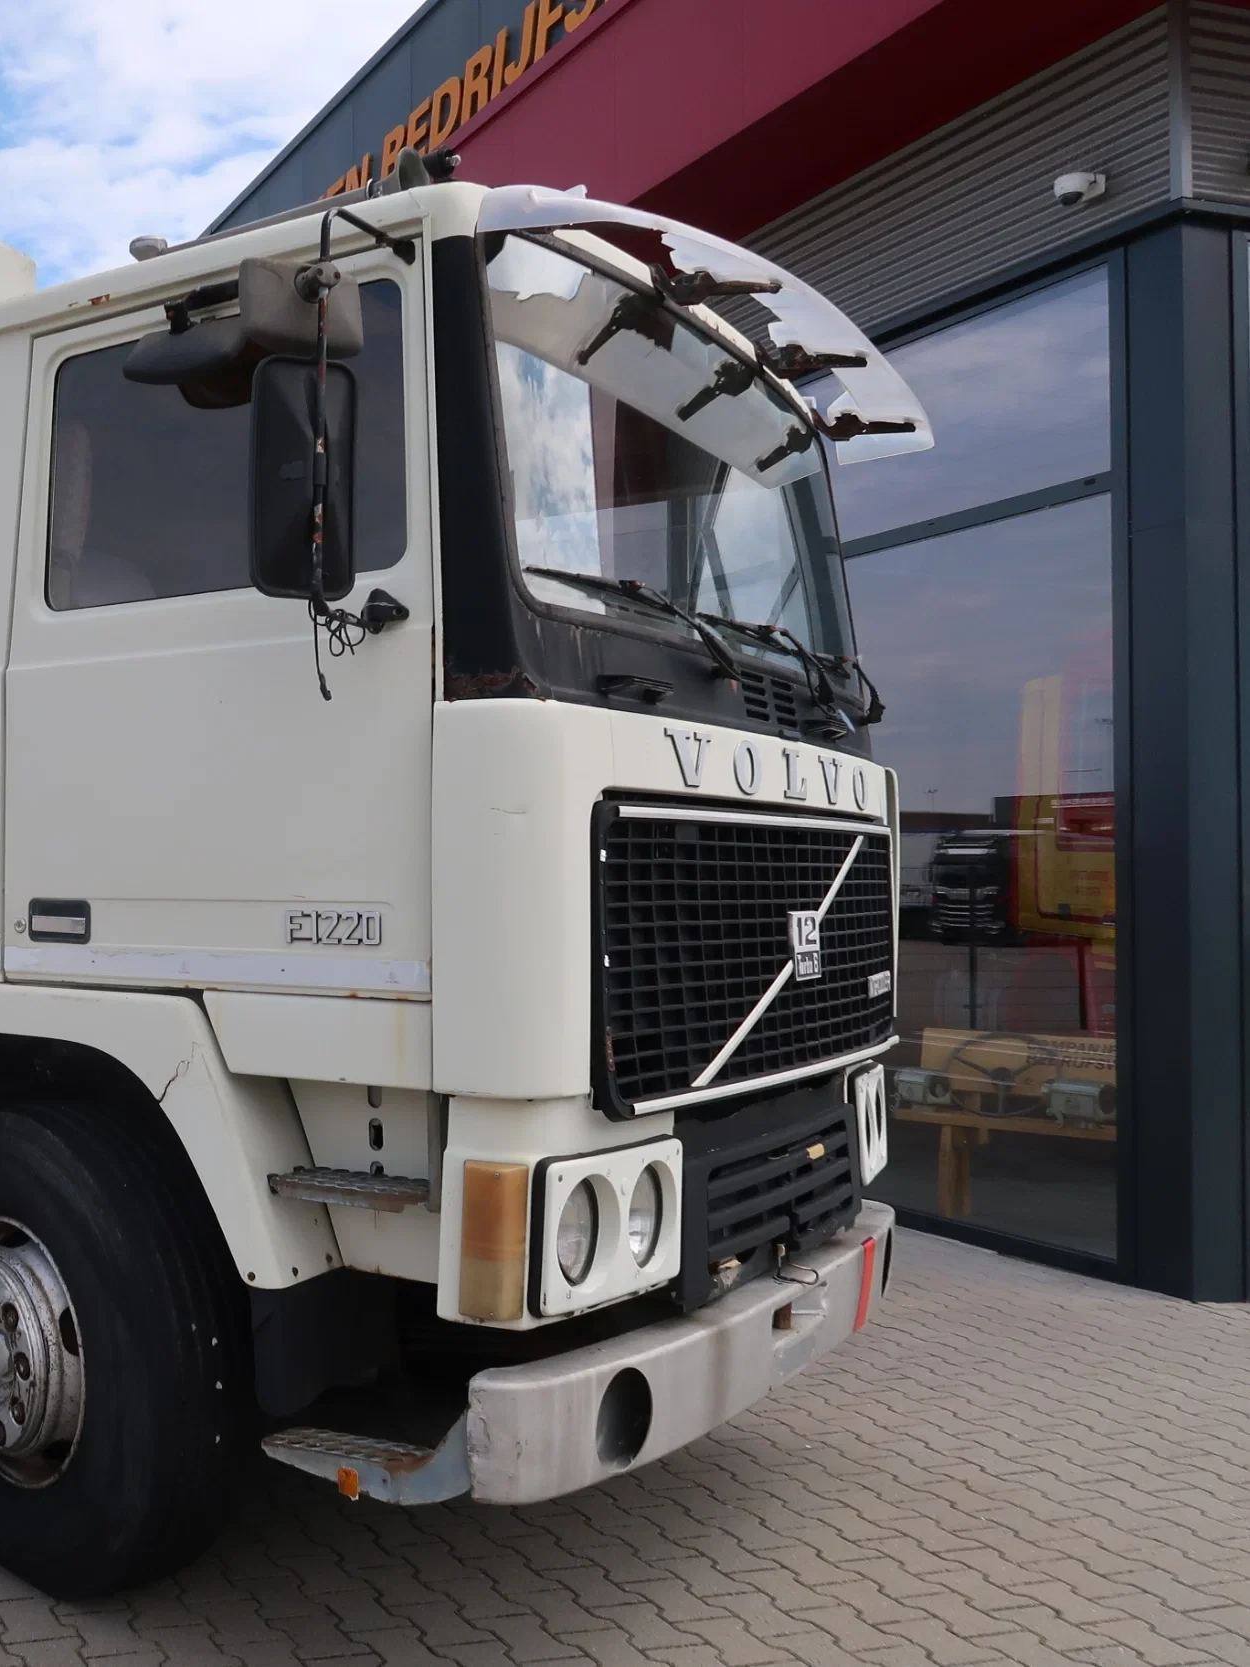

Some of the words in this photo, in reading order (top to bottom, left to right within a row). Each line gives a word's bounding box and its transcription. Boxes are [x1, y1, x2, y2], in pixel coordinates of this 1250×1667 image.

[665, 727, 867, 811] VOLVO
[285, 910, 382, 945] F1220
[797, 917, 817, 946] 12
